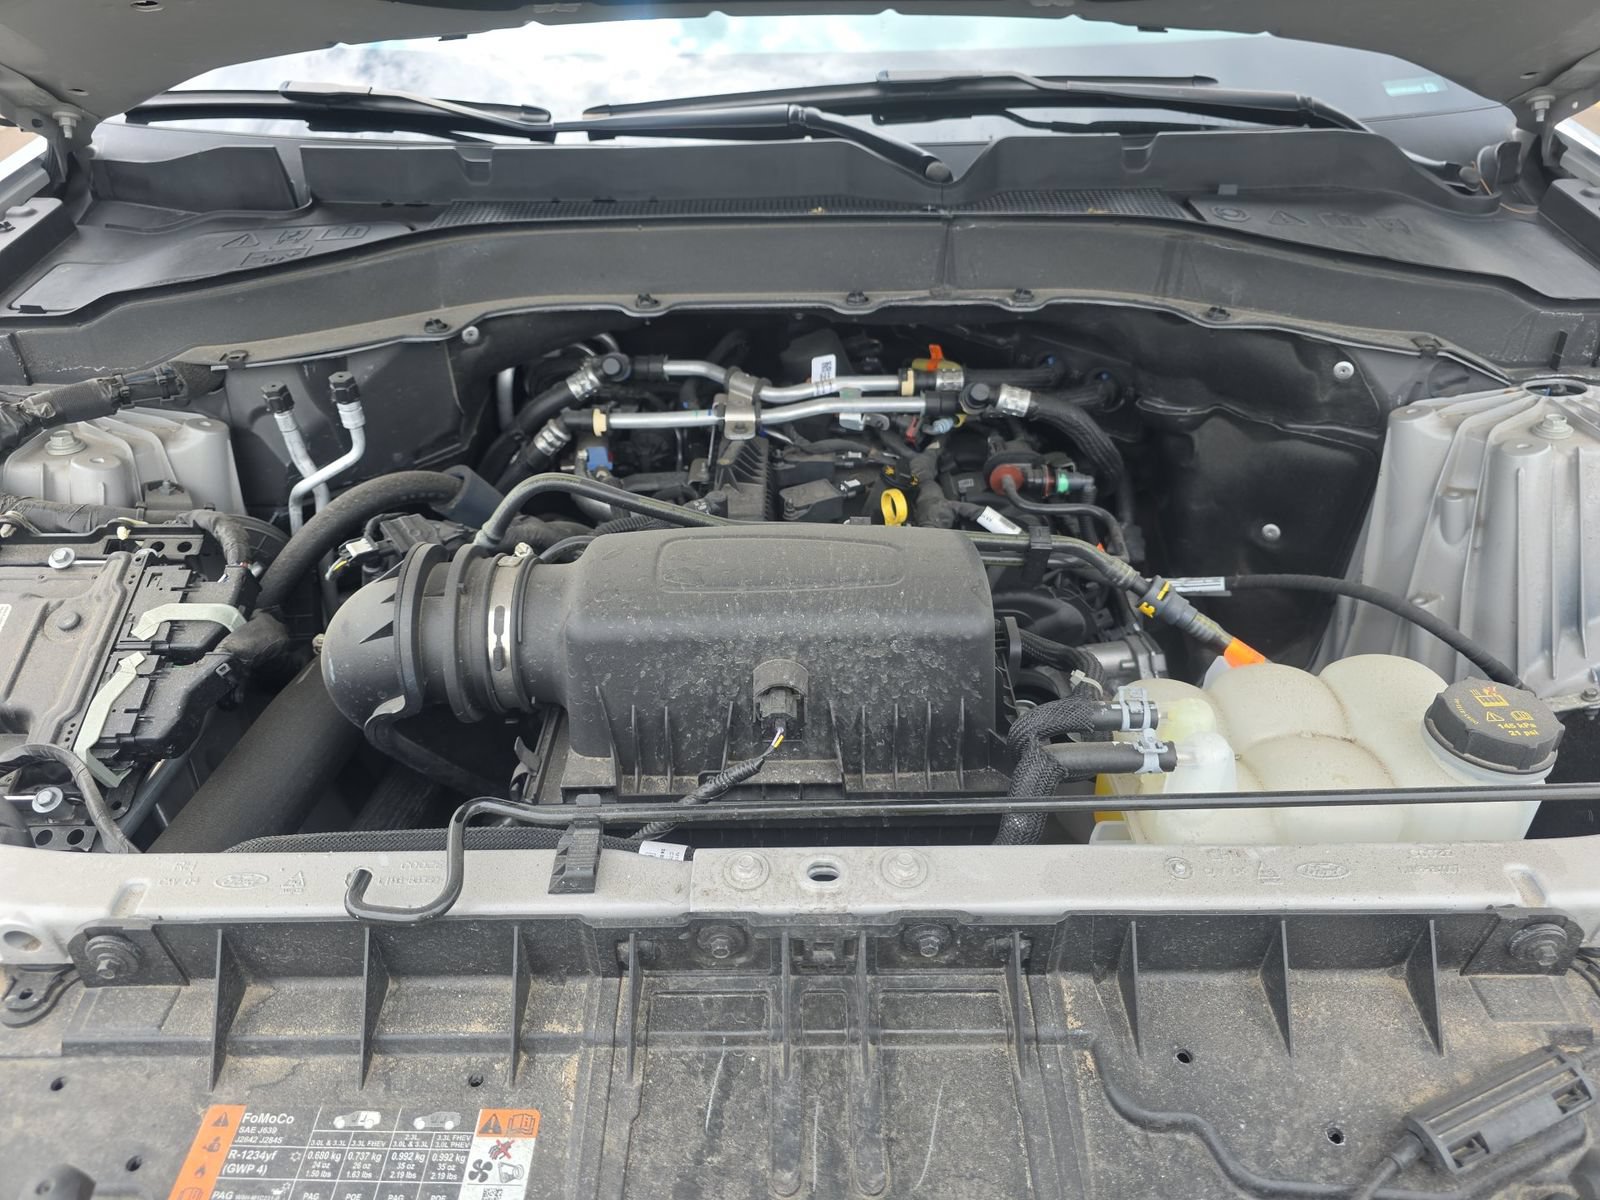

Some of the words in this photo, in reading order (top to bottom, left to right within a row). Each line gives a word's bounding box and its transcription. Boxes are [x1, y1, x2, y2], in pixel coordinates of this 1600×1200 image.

[242, 1112, 295, 1124] FoMoCo
[238, 1126, 257, 1134] SAE
[257, 1126, 278, 1134] J639
[228, 1149, 278, 1161] R-1234yf
[307, 1151, 330, 1160] 0.680
[330, 1152, 342, 1163] kg
[347, 1151, 371, 1160] 0.737
[371, 1152, 382, 1162] kg
[391, 1152, 415, 1161] 0.992
[414, 1153, 426, 1163] kg
[431, 1153, 455, 1162] 0.992
[455, 1153, 467, 1164] kg
[221, 1164, 256, 1175] (GWP
[255, 1165, 268, 1176] 4)
[320, 1170, 332, 1178] lbs
[346, 1170, 360, 1178] 1.63
[389, 1171, 405, 1179] 2.19
[405, 1171, 417, 1179] lbs
[430, 1172, 446, 1180] 2.19
[446, 1172, 458, 1180] lbs
[211, 1190, 234, 1200] PAG
[303, 1192, 320, 1200] PAG
